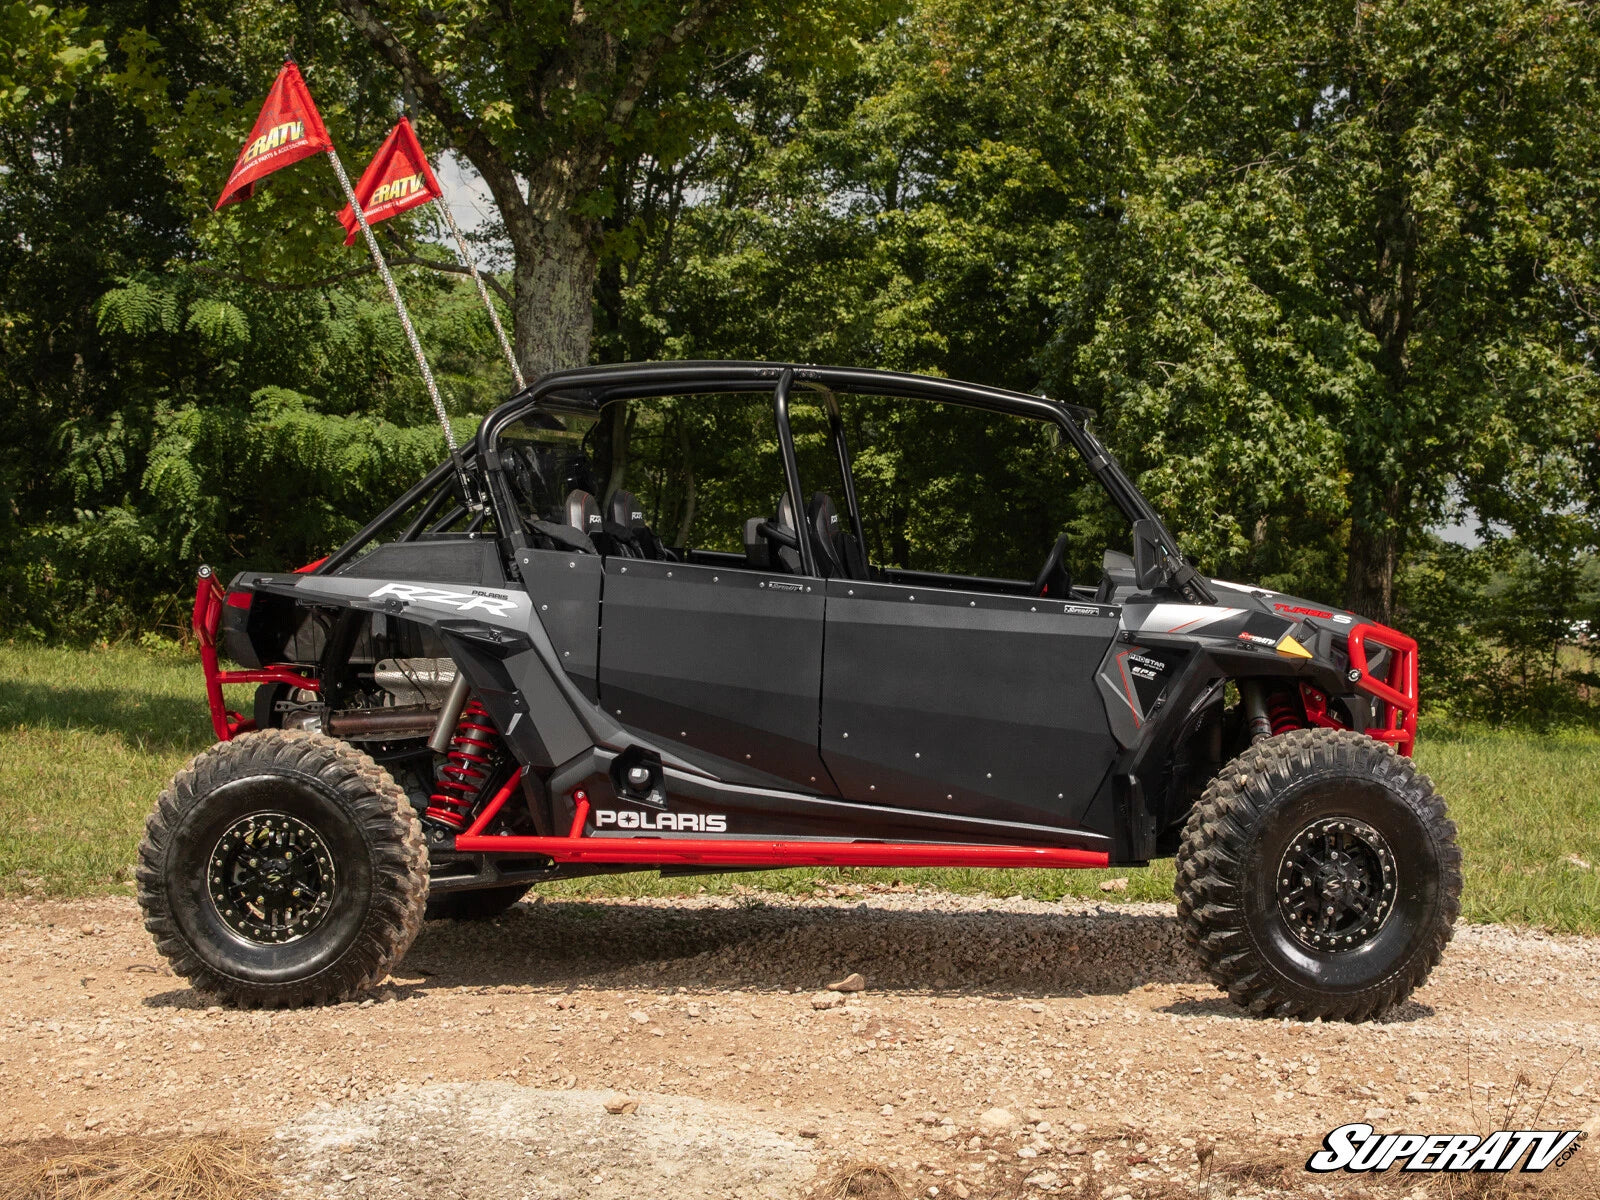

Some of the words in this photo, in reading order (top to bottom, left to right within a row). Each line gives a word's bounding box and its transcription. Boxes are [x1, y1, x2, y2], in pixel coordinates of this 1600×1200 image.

[369, 583, 519, 618] RZR
[471, 589, 508, 601] POLARIS
[1273, 603, 1333, 620] TURBO
[1129, 653, 1165, 669] PROSTAR
[596, 810, 727, 833] POLARIS
